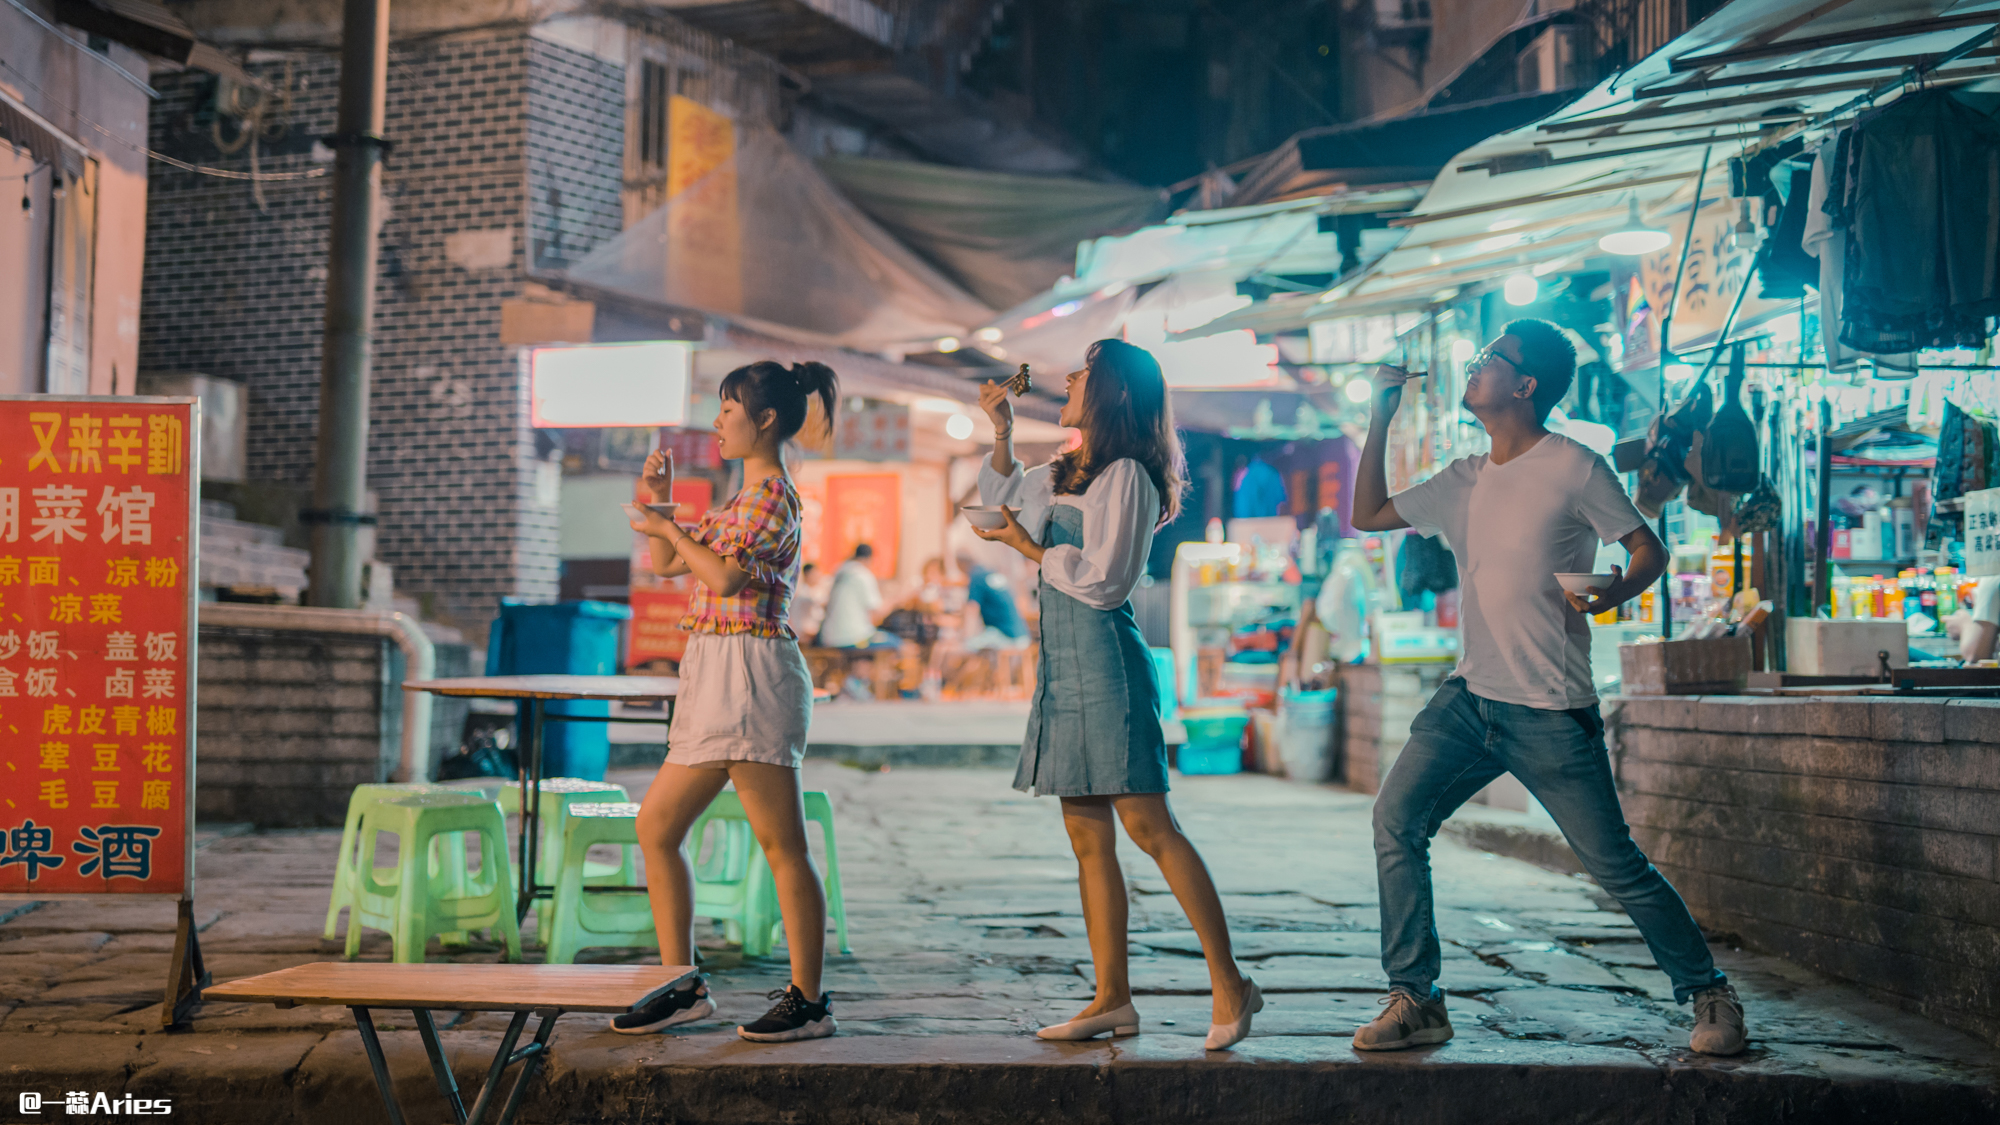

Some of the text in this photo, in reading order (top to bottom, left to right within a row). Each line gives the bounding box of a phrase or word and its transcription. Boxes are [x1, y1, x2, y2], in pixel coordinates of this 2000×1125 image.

[28, 411, 182, 475] 又来辛勤
[0, 818, 162, 881] 啤酒
